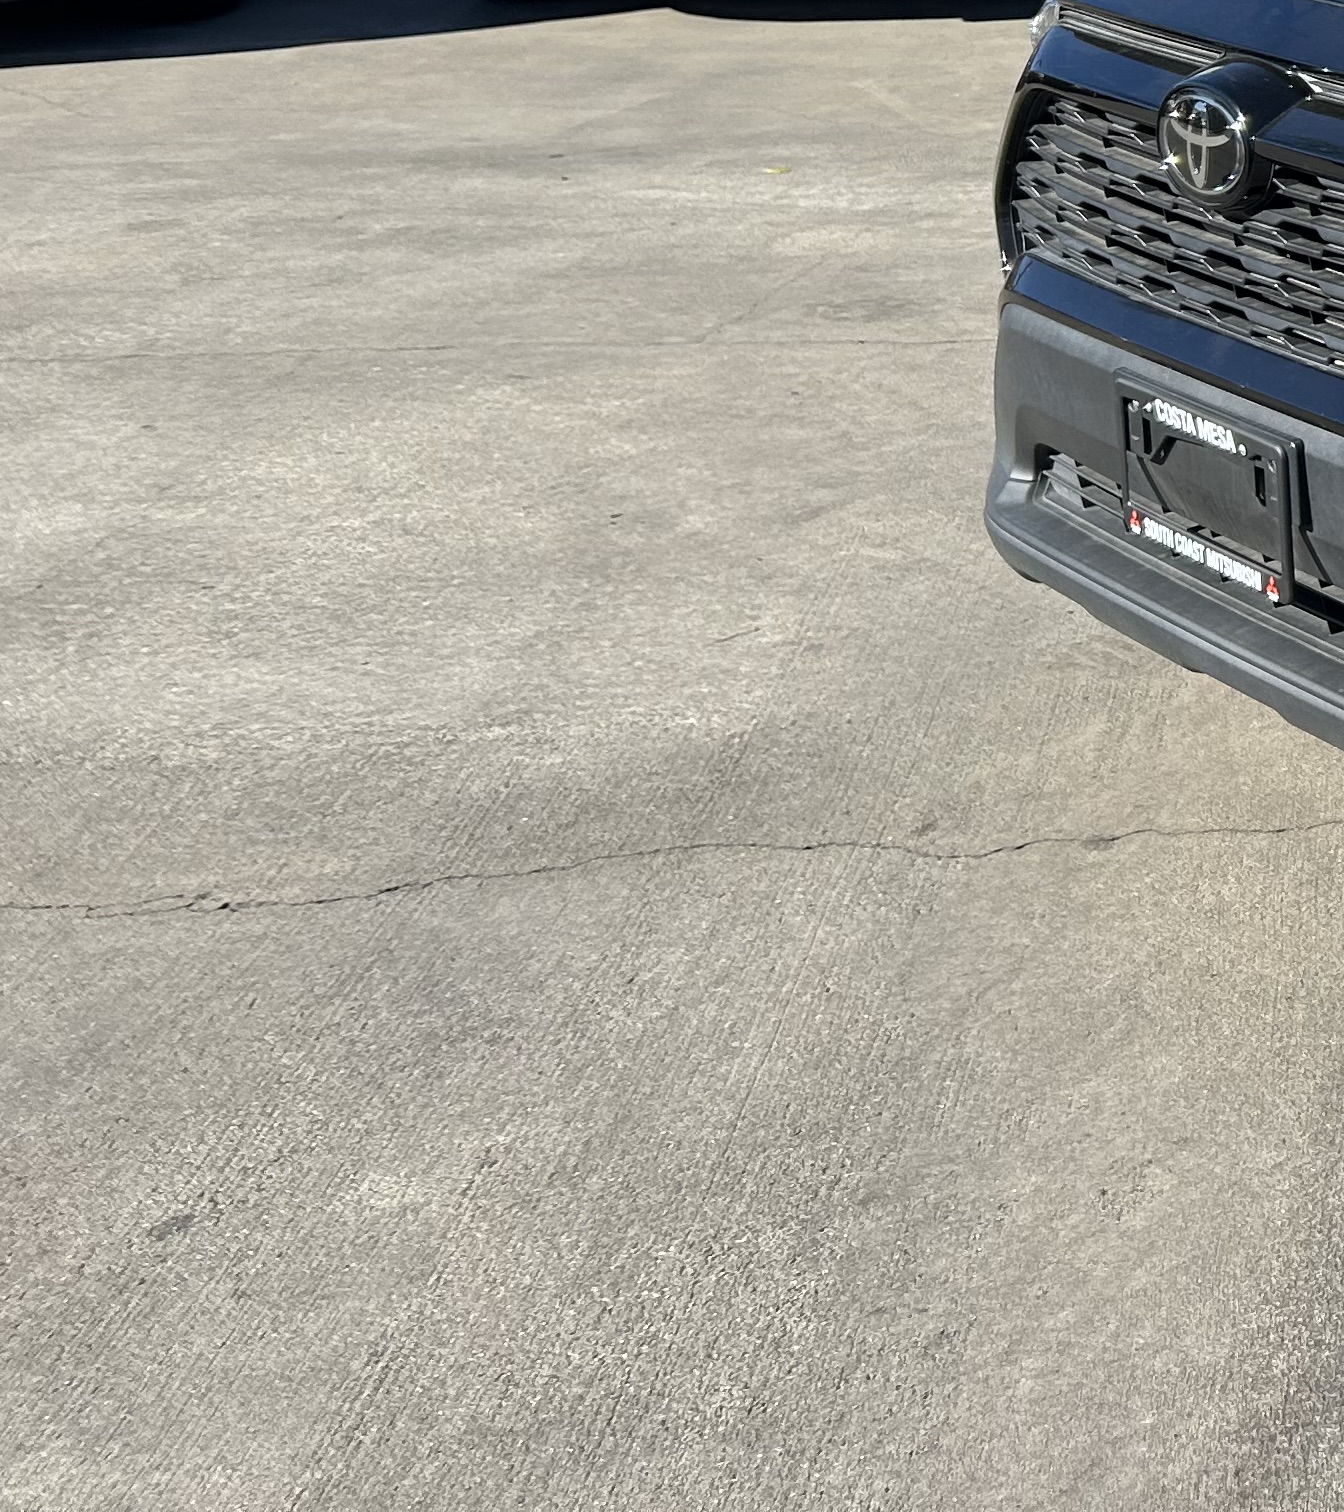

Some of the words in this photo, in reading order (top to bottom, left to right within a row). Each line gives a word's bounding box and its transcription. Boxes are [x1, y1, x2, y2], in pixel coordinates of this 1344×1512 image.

[1153, 398, 1196, 437] COSTA
[1196, 416, 1237, 454] MESA
[1142, 517, 1174, 549] SOUTH
[1174, 532, 1205, 564] COAST
[1206, 548, 1262, 592] MITSUBISHI
